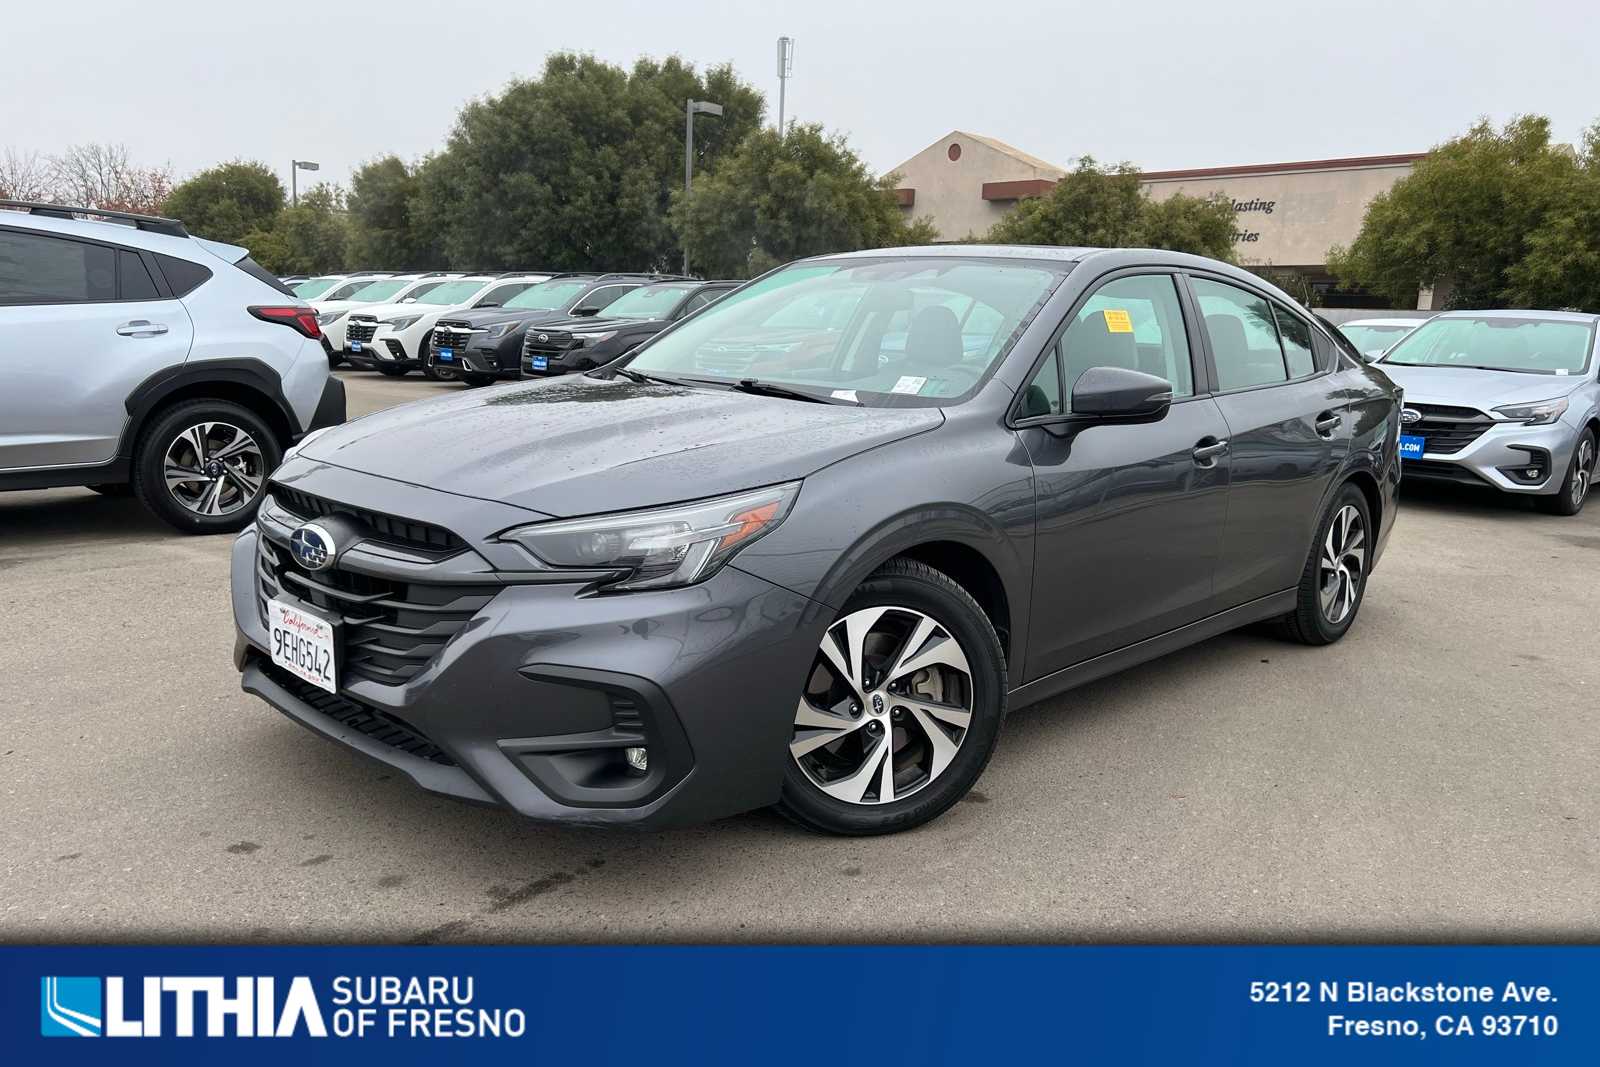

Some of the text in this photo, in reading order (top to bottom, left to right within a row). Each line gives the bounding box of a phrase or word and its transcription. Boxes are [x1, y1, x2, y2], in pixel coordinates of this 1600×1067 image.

[1212, 198, 1275, 214] lasting
[283, 608, 322, 638] California
[274, 627, 331, 681] 9EHG542
